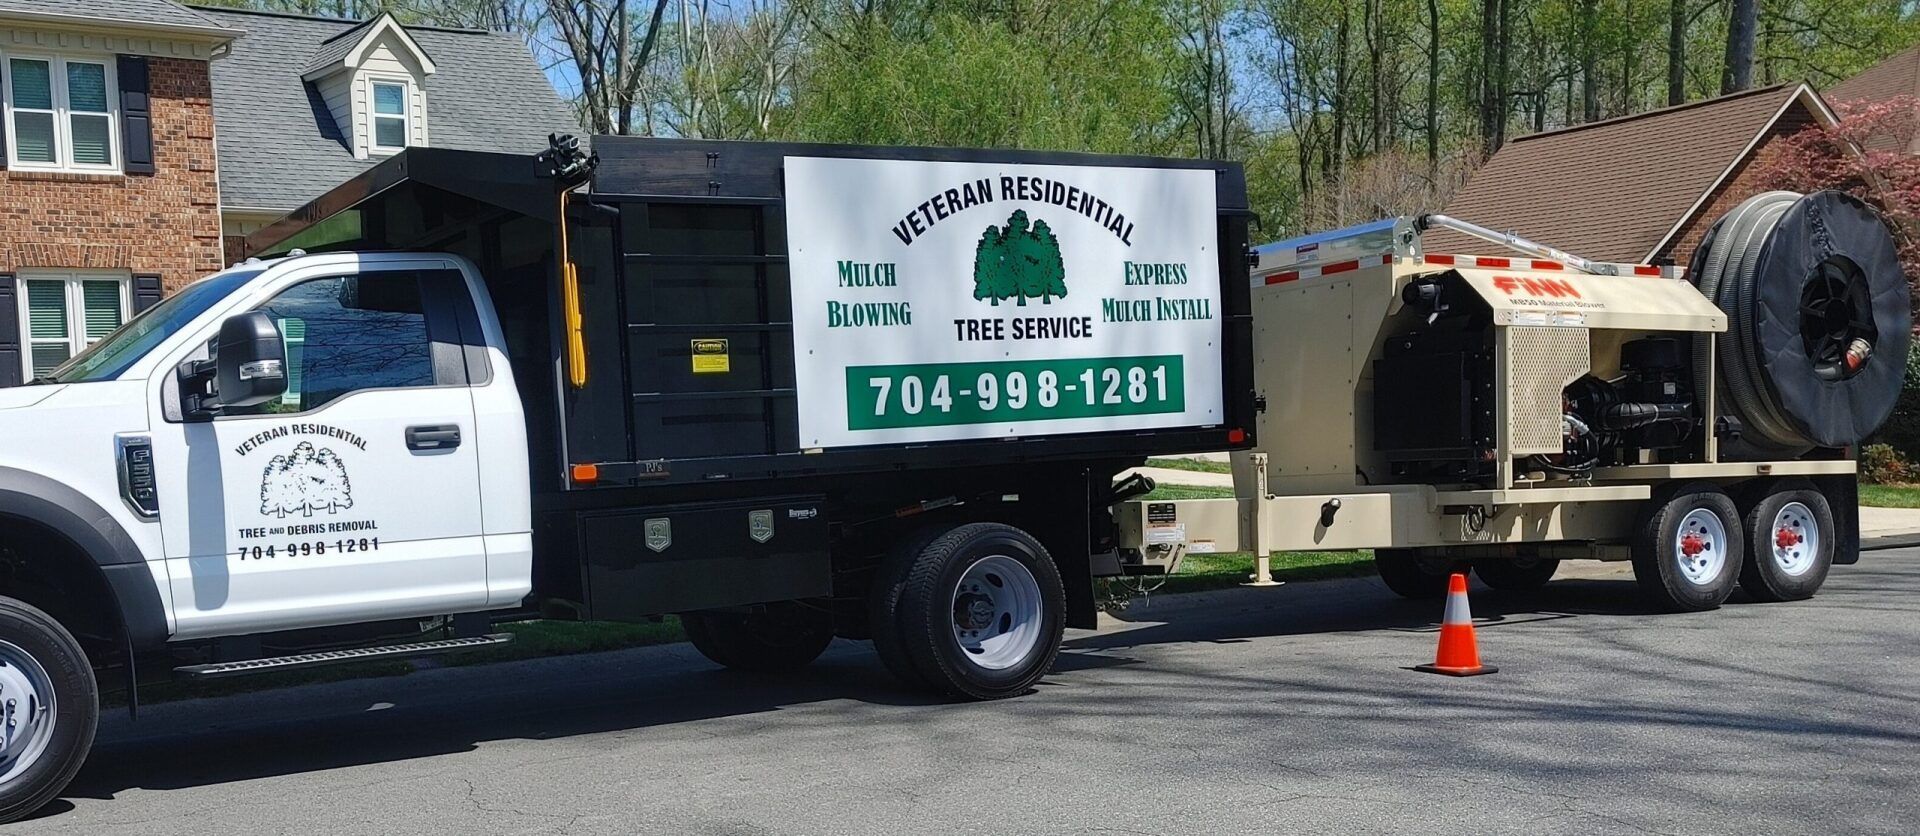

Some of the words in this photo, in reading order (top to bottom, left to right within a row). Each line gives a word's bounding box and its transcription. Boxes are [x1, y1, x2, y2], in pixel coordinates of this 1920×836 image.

[892, 178, 994, 247] VETERAN
[1000, 176, 1137, 247] RESIDENTIAL
[837, 260, 897, 287] MULCH
[1124, 261, 1187, 286] EXPRESS
[827, 301, 912, 328] BLOWING
[1102, 299, 1152, 322] MULCH
[1156, 298, 1213, 321] INSTALL
[1540, 299, 1576, 307] Material
[1576, 301, 1606, 309] Blower
[954, 318, 1005, 341] TREE
[1011, 316, 1093, 340] SERVICE
[869, 365, 1168, 416] 704-998-1281
[235, 426, 288, 457] VETERAN
[292, 424, 368, 451] RESIDENTIAL
[238, 528, 267, 538] TREE
[269, 527, 285, 535] AND
[287, 523, 326, 536] DEBRIS
[328, 520, 378, 533] REMOVAL
